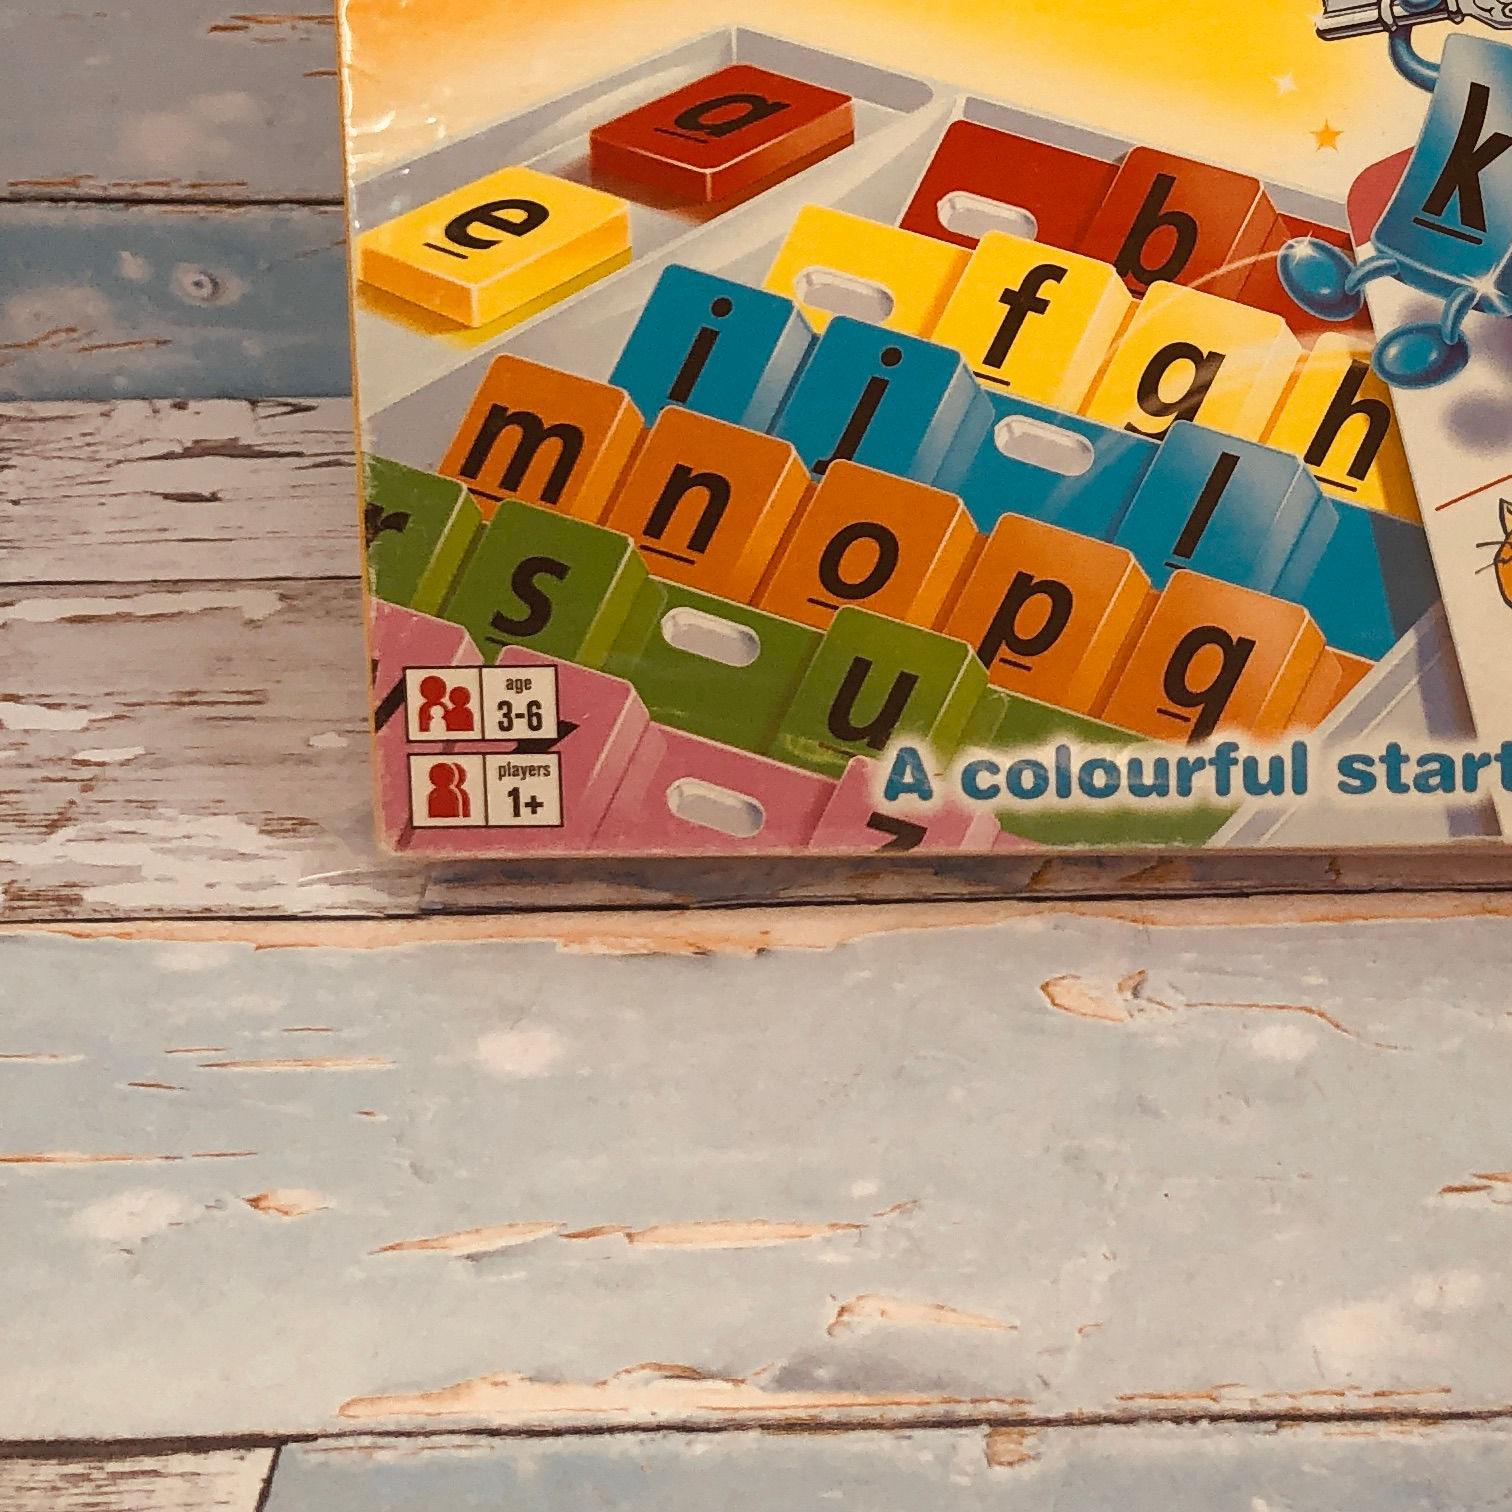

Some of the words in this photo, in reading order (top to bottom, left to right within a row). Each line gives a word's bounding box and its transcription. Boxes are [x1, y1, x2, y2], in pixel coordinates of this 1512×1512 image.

[673, 92, 791, 139] a
[444, 198, 550, 251] e
[1116, 171, 1198, 286] b
[667, 297, 734, 404] i
[981, 263, 1068, 369] f
[1123, 339, 1227, 442] g
[1302, 358, 1392, 481] h
[458, 403, 585, 505] m
[641, 462, 732, 555] n
[817, 521, 901, 601] o
[971, 568, 1074, 669] p
[1162, 623, 1257, 745] q
[489, 555, 572, 637] s
[827, 654, 920, 752] u
[505, 674, 532, 694] age
[497, 700, 544, 733] 3-6
[497, 759, 551, 781] players
[884, 745, 935, 801] A
[960, 738, 1308, 801] colourful
[506, 791, 544, 818] 1+
